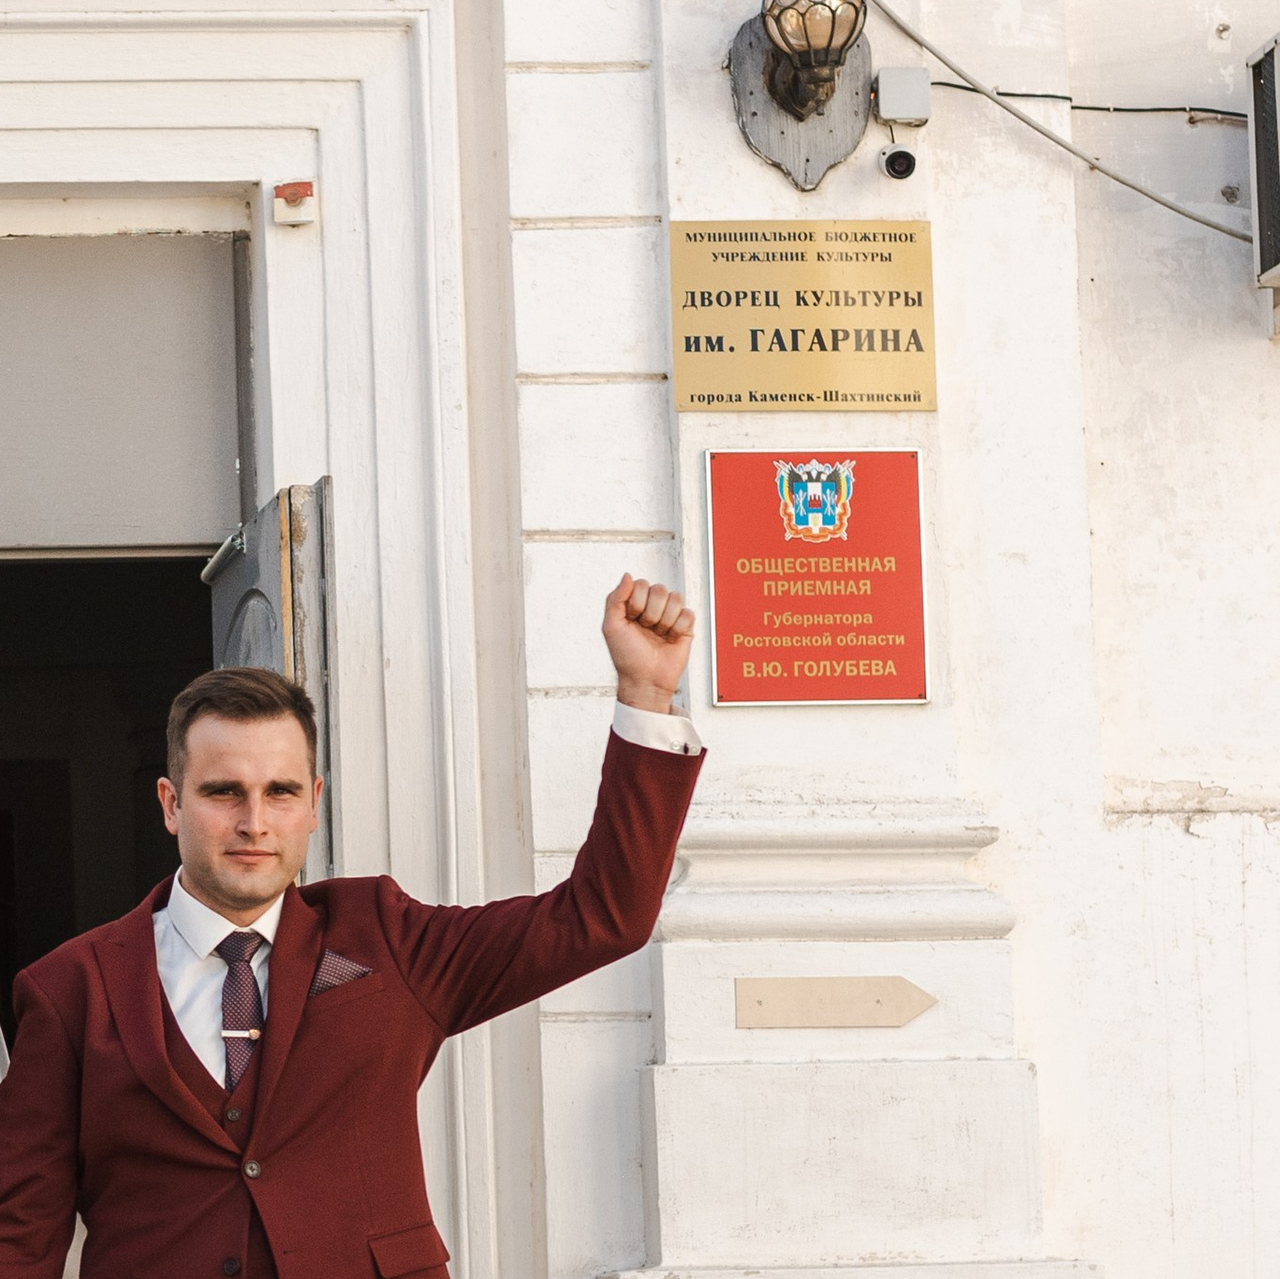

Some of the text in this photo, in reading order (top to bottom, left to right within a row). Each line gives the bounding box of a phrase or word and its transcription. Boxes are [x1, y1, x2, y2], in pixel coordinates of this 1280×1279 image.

[685, 231, 917, 243] МУНИЦИПАЛЬНОЕ БЮДЖЕТНОЕ
[711, 251, 893, 263] УЧРЕЖДЕНИЕ КУЛЬТУРЫ
[682, 290, 924, 310] ДВОРЕЦ КУЛЬТУРЫ
[683, 328, 925, 353] им. ГАГАРИНА
[689, 389, 922, 405] города Каменск-Шахтинский
[736, 556, 897, 576] ОБЩЕСТВЕННАЯ
[763, 580, 872, 596] ПРИЕМНАЯ
[763, 610, 873, 628] Губернатора
[733, 631, 905, 647] Ростовской области
[742, 660, 897, 677] В.Ю. ГОЛУБЕВА
